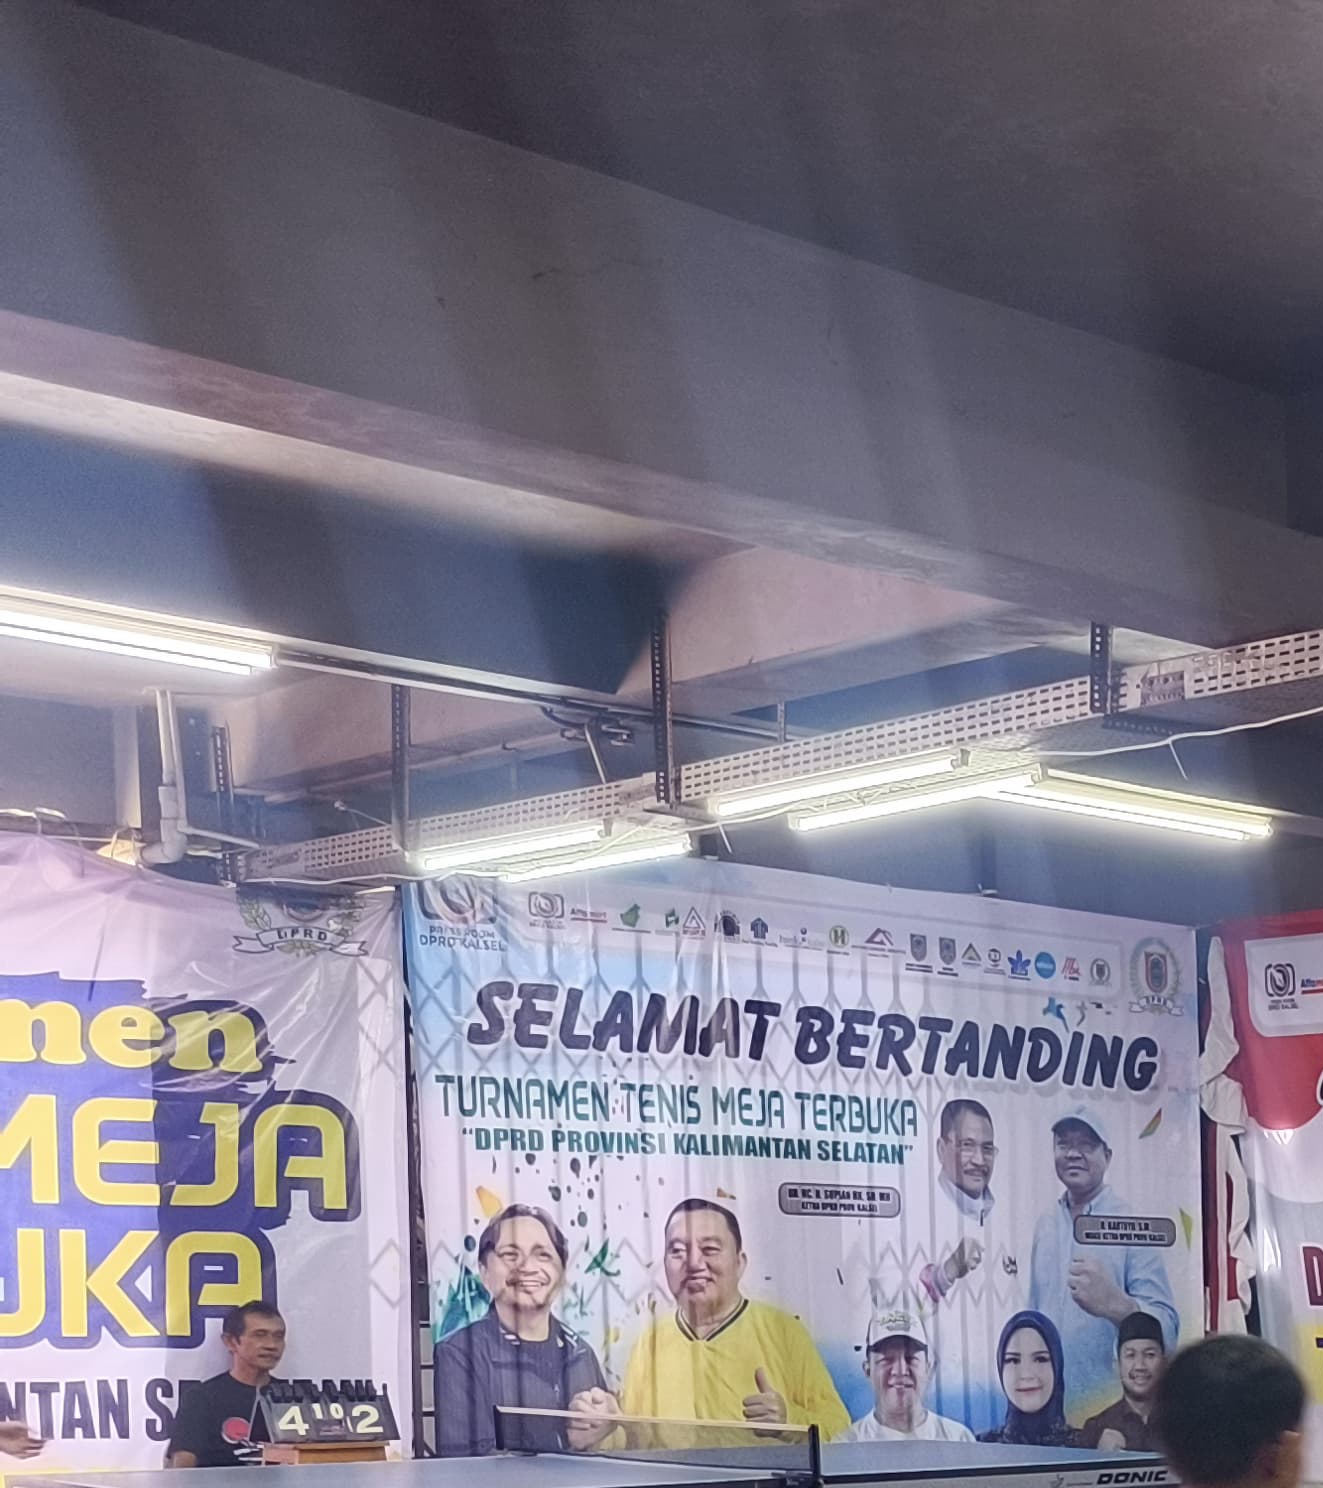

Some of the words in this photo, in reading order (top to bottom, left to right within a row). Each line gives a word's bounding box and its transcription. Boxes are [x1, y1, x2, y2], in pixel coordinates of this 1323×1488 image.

[467, 981, 781, 1061] SELAMAT
[795, 1005, 1159, 1093] BERTANDING
[435, 1075, 609, 1124] TURNAMEN
[620, 1083, 701, 1125] TENIS
[712, 1086, 785, 1129] MEJA
[795, 1092, 918, 1137] TERBUKA
[552, 1131, 667, 1156] PROVINSI
[674, 1133, 812, 1161] KALIMANTAN
[277, 1405, 310, 1436] 4
[351, 1403, 385, 1434] 2
[1096, 1470, 1168, 1485] DONIC
